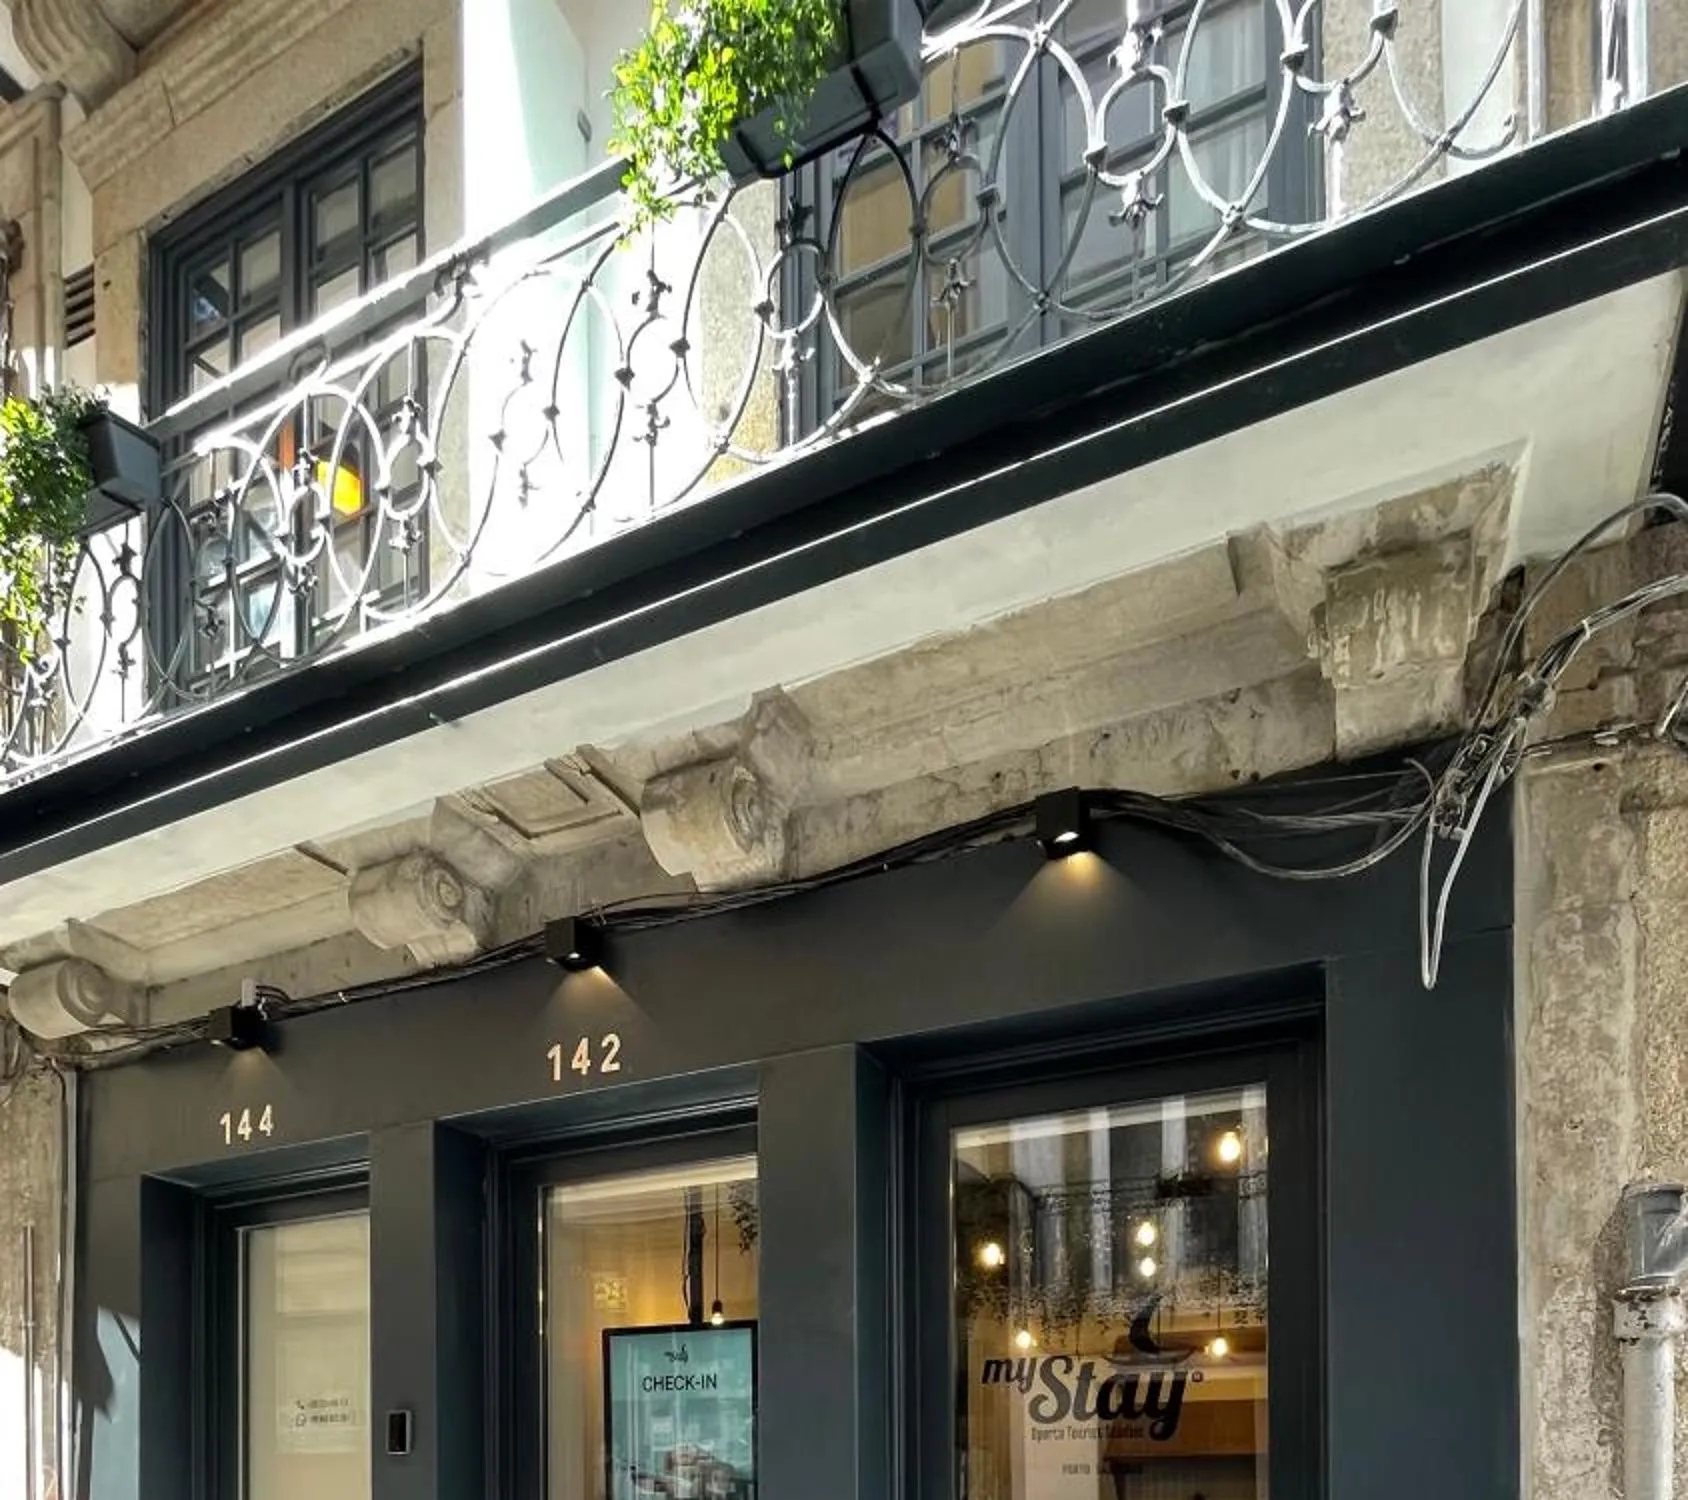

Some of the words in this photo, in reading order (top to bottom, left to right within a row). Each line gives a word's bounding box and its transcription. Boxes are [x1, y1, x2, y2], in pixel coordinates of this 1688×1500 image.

[546, 1033, 621, 1081] 142
[219, 1104, 275, 1145] 144
[642, 1373, 718, 1393] CHECK-IN
